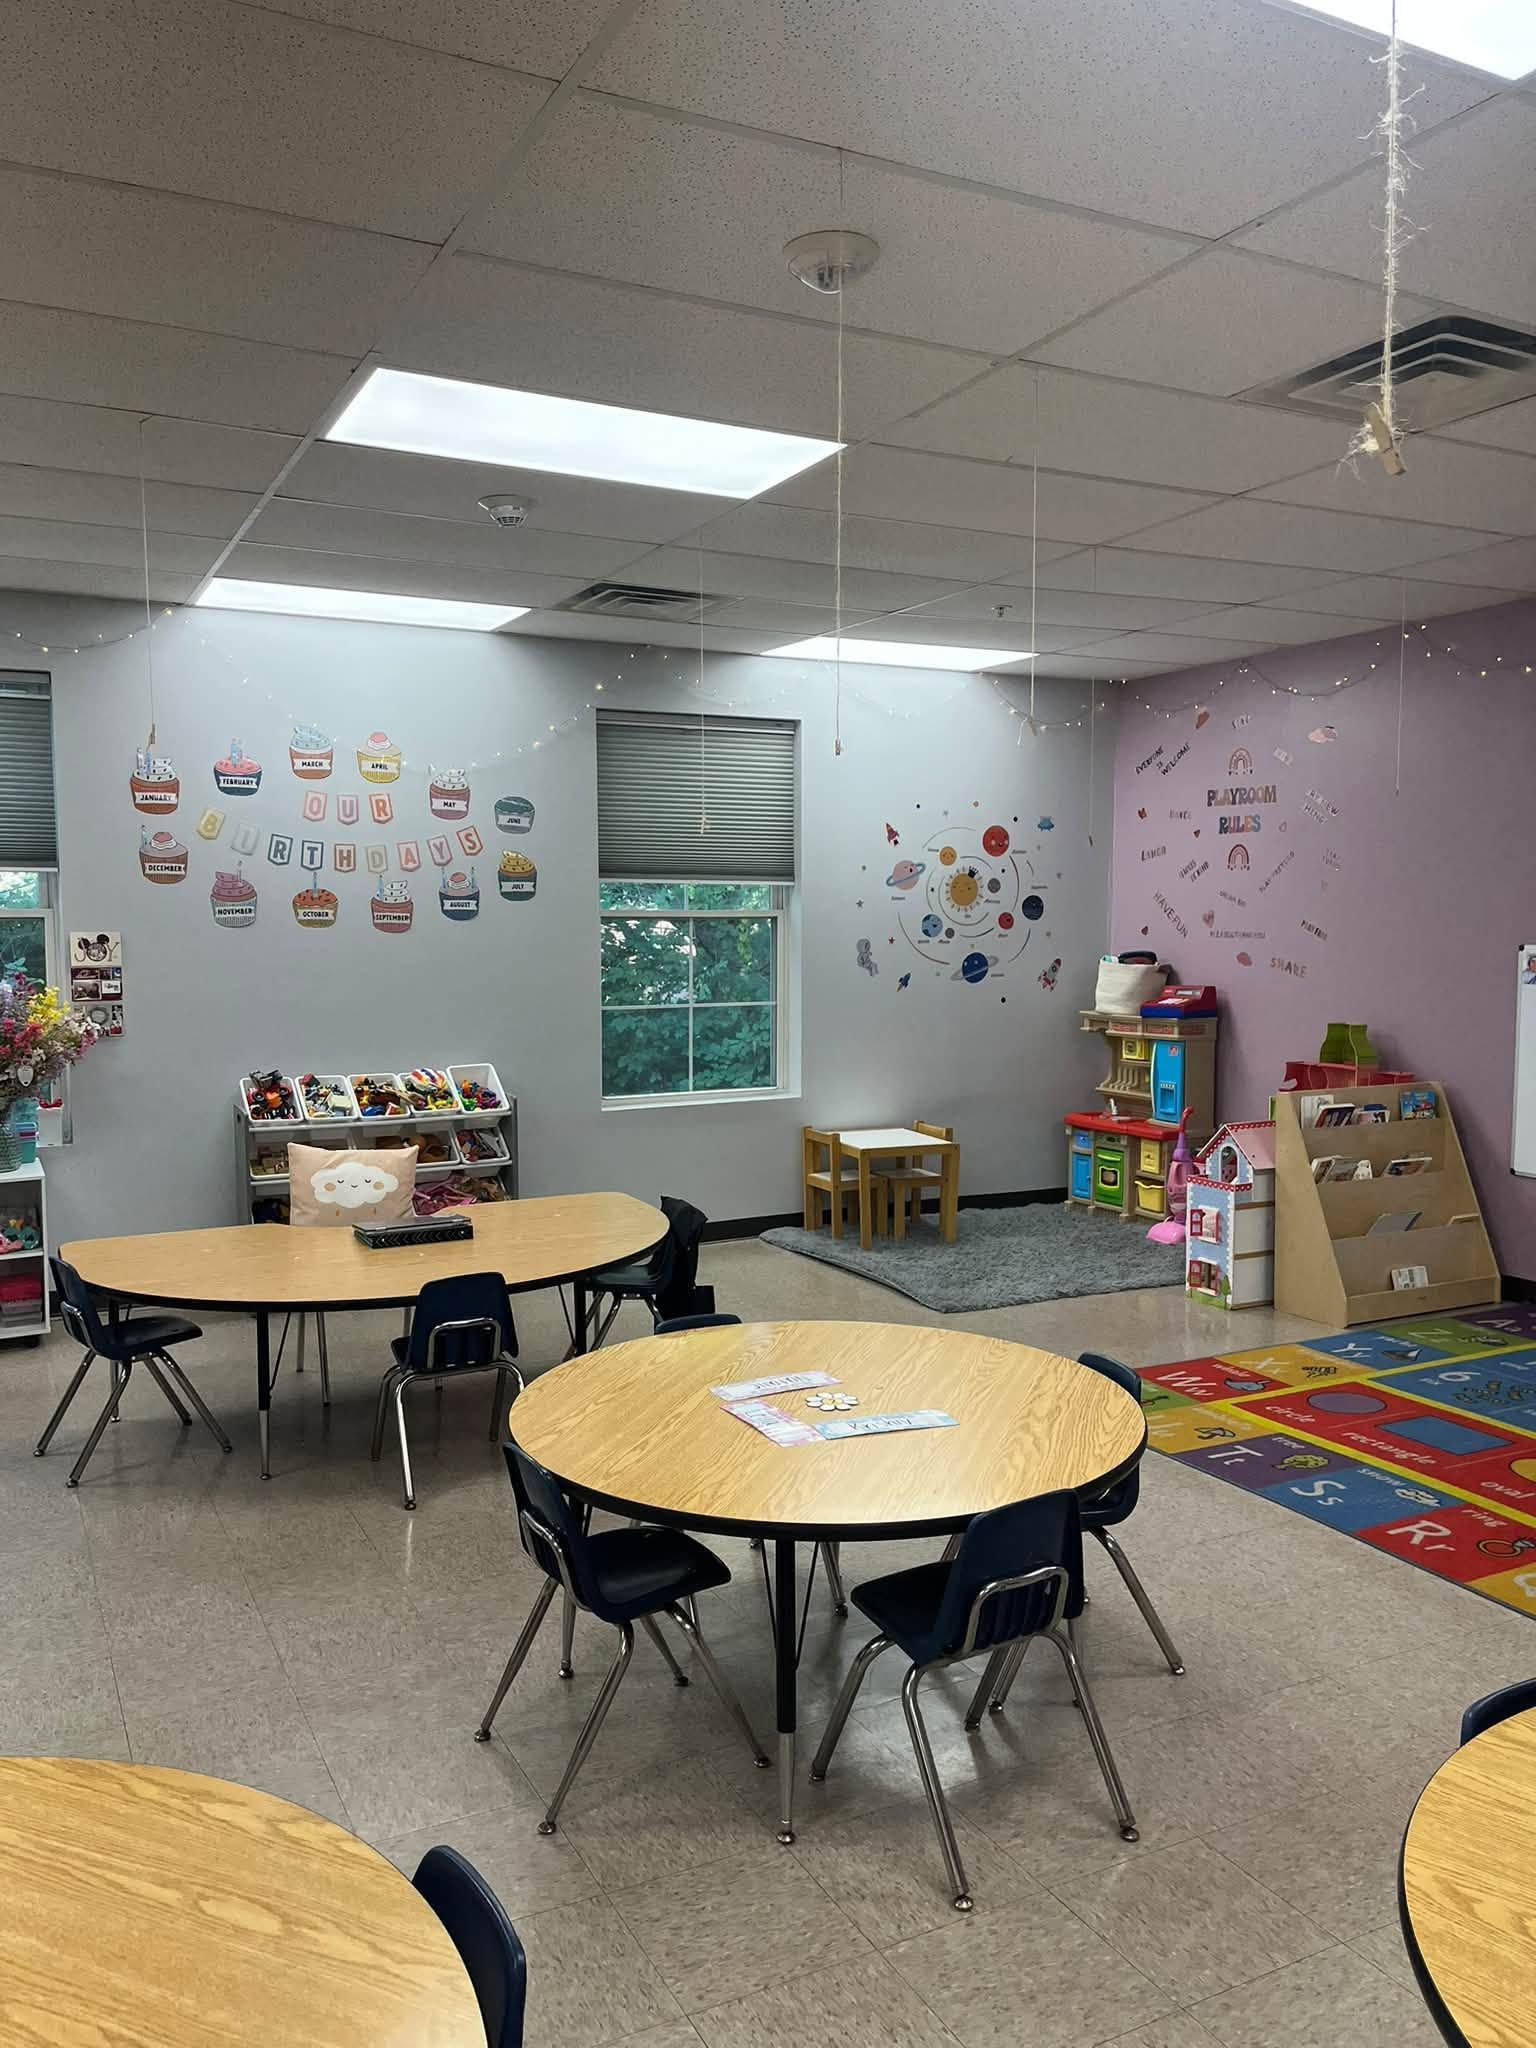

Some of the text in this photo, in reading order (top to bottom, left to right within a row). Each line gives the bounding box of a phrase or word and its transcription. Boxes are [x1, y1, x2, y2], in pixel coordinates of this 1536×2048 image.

[301, 760, 324, 768] MARCH
[371, 762, 389, 771] APRIL
[222, 777, 254, 786] FEBRUARY
[140, 793, 172, 801] JANUARY
[1206, 785, 1277, 807] PLAYROOM
[309, 793, 392, 823] OUR
[506, 817, 521, 825] JUNE
[1218, 815, 1262, 835] RULES
[199, 811, 481, 872] BIRTHDAYS
[147, 864, 182, 872] DECEMBER
[449, 901, 471, 909] AUGUST
[217, 907, 253, 916] NOVEMBER
[302, 910, 329, 918] OCTOBER
[375, 913, 410, 922] SEPTEMBER
[1270, 957, 1310, 978] SHARE
[1438, 1371, 1482, 1383] 6
[1264, 1404, 1316, 1424] circle
[1272, 1436, 1305, 1449] tree
[1341, 1432, 1437, 1465] rectangle
[1356, 1467, 1407, 1487] snow
[1479, 1480, 1536, 1500] oval
